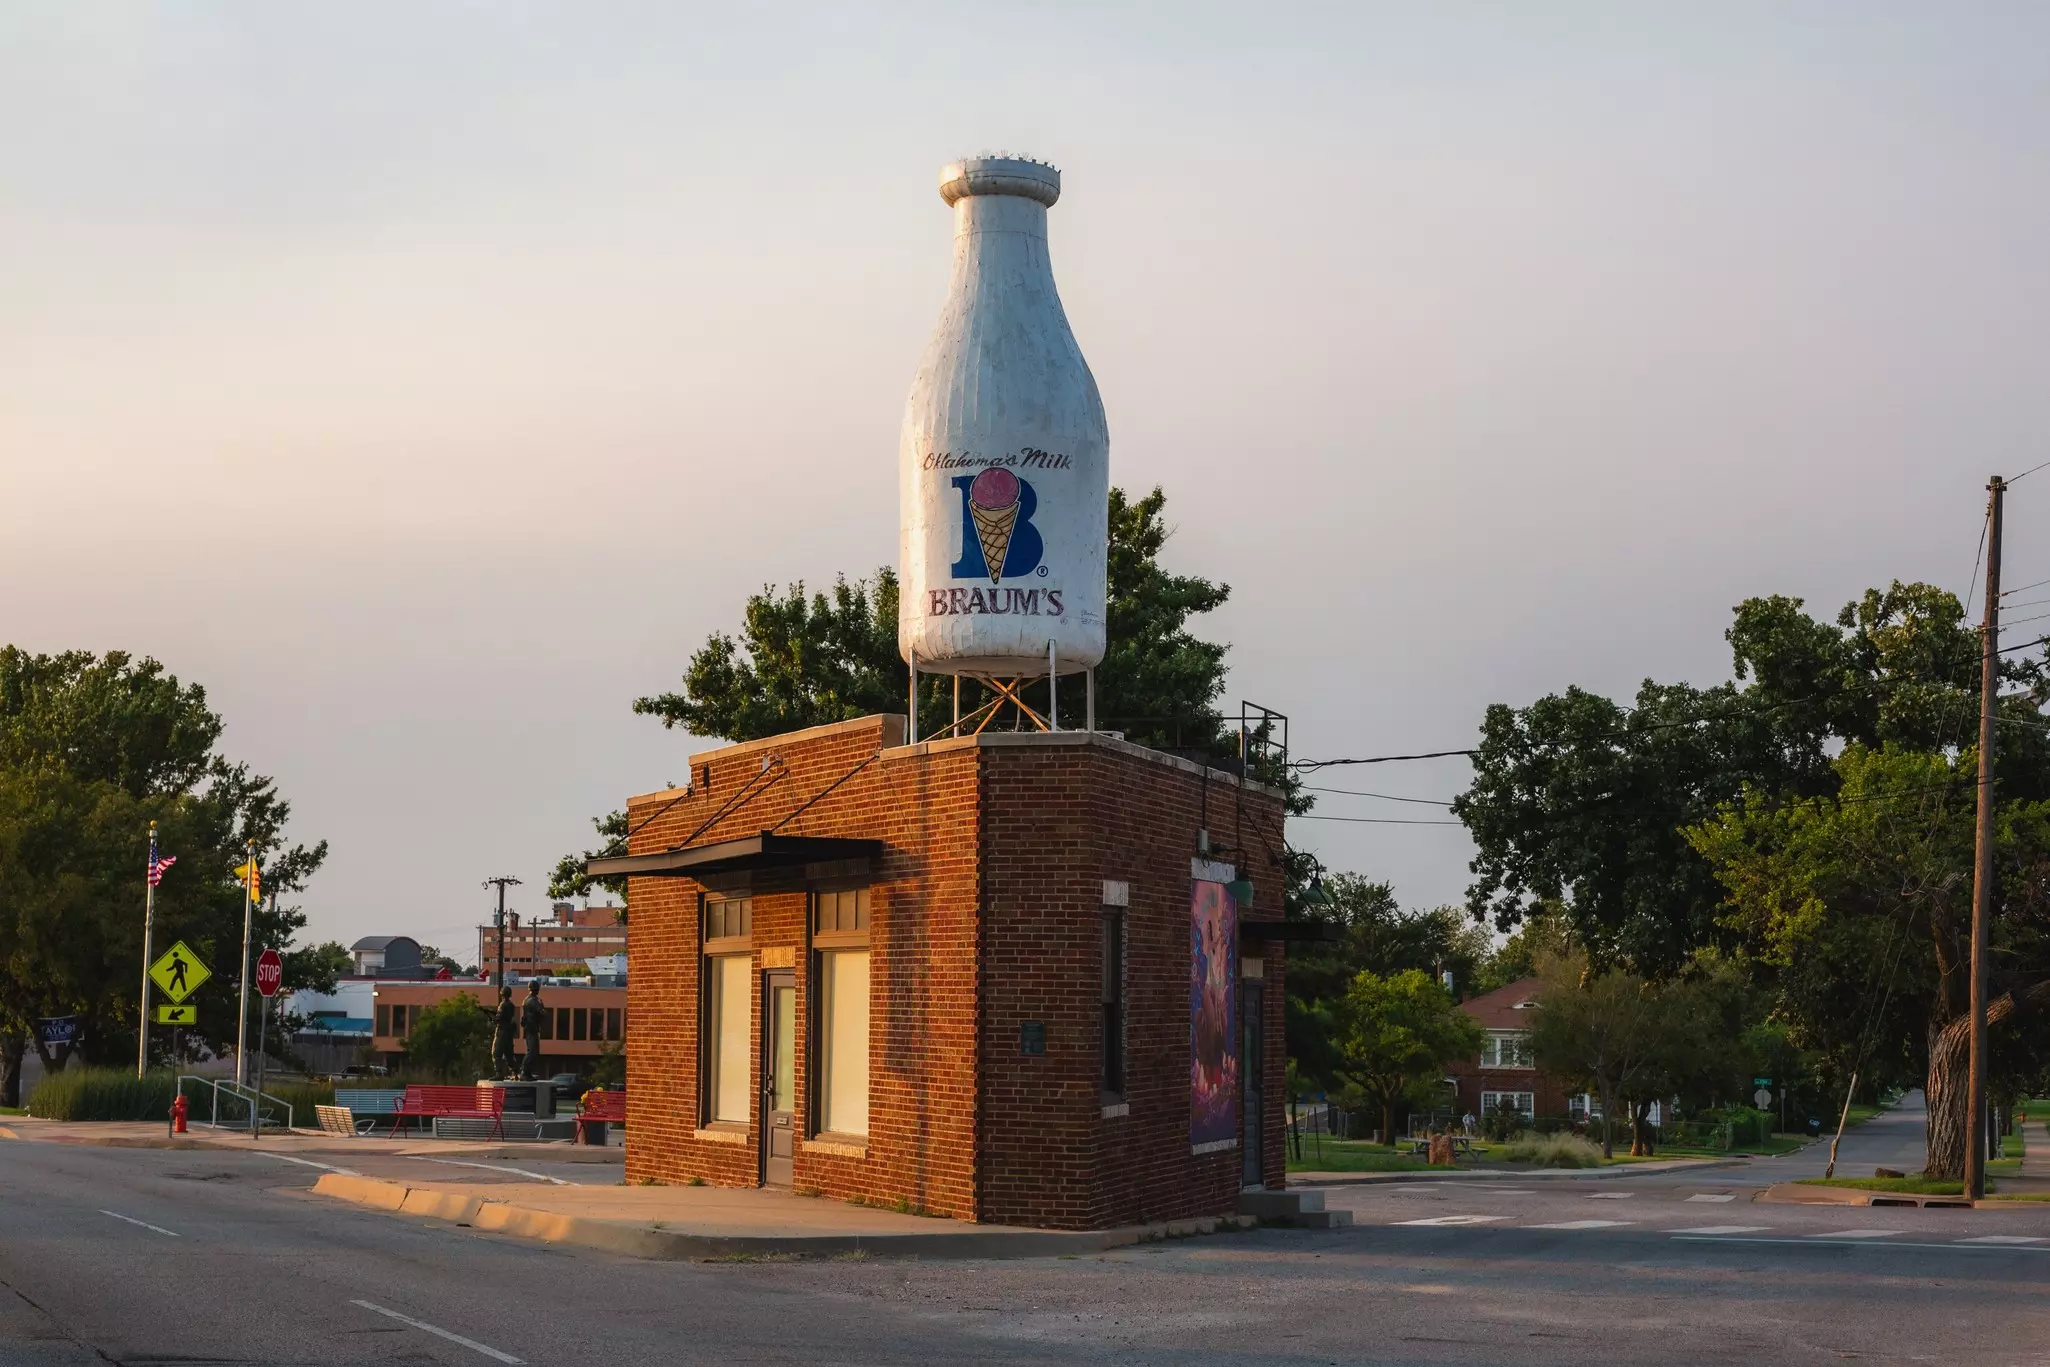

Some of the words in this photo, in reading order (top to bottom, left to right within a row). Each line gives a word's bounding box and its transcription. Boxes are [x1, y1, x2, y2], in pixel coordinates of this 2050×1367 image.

[923, 451, 1018, 470] Oklahoma's
[1020, 447, 1073, 470] Milk
[928, 587, 1065, 617] BRAUM'S
[258, 964, 281, 983] STOP
